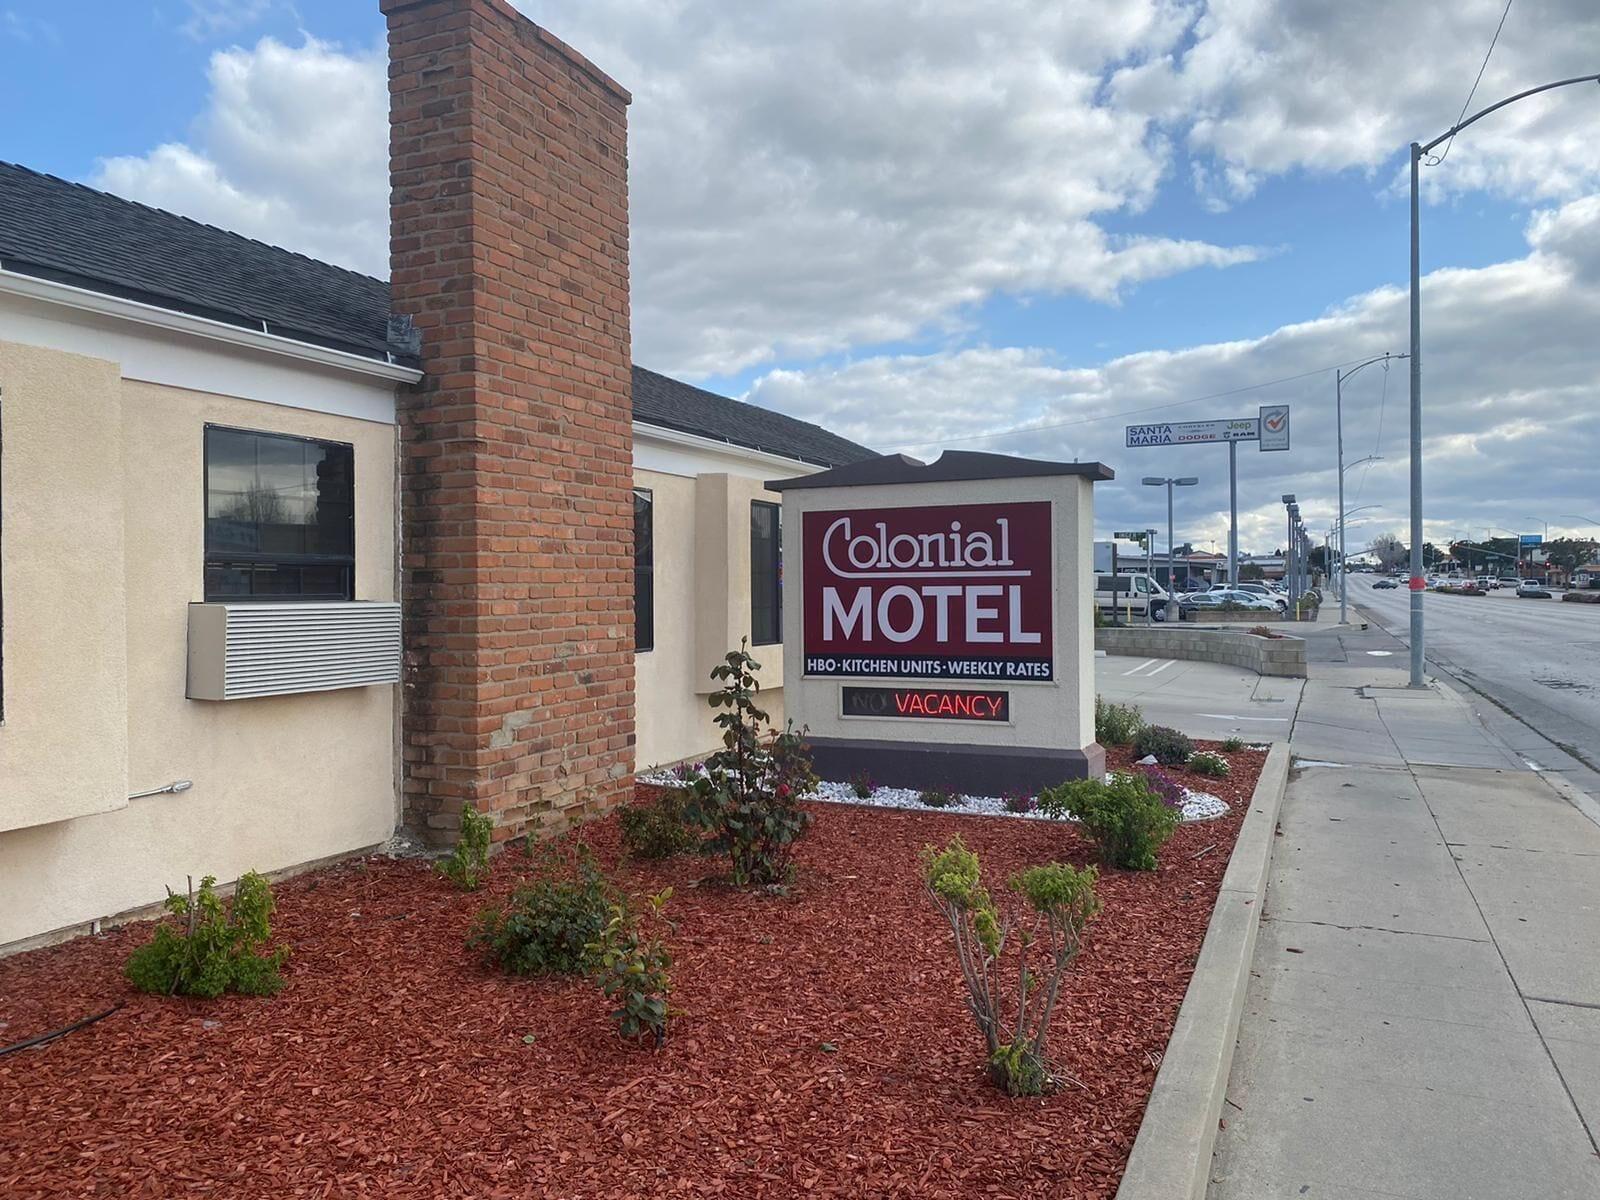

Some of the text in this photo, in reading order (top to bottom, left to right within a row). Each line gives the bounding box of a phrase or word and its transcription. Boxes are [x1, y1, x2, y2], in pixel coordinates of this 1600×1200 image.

[1129, 425, 1172, 437] SANTA
[1227, 421, 1251, 430] Jeep
[1130, 435, 1172, 445] MARIA
[1178, 433, 1216, 441] DODGE
[823, 517, 1022, 578] Colonial
[823, 585, 1042, 643] MOTEL
[1007, 662, 1050, 677] RATES
[895, 692, 1002, 717] VACANCY
